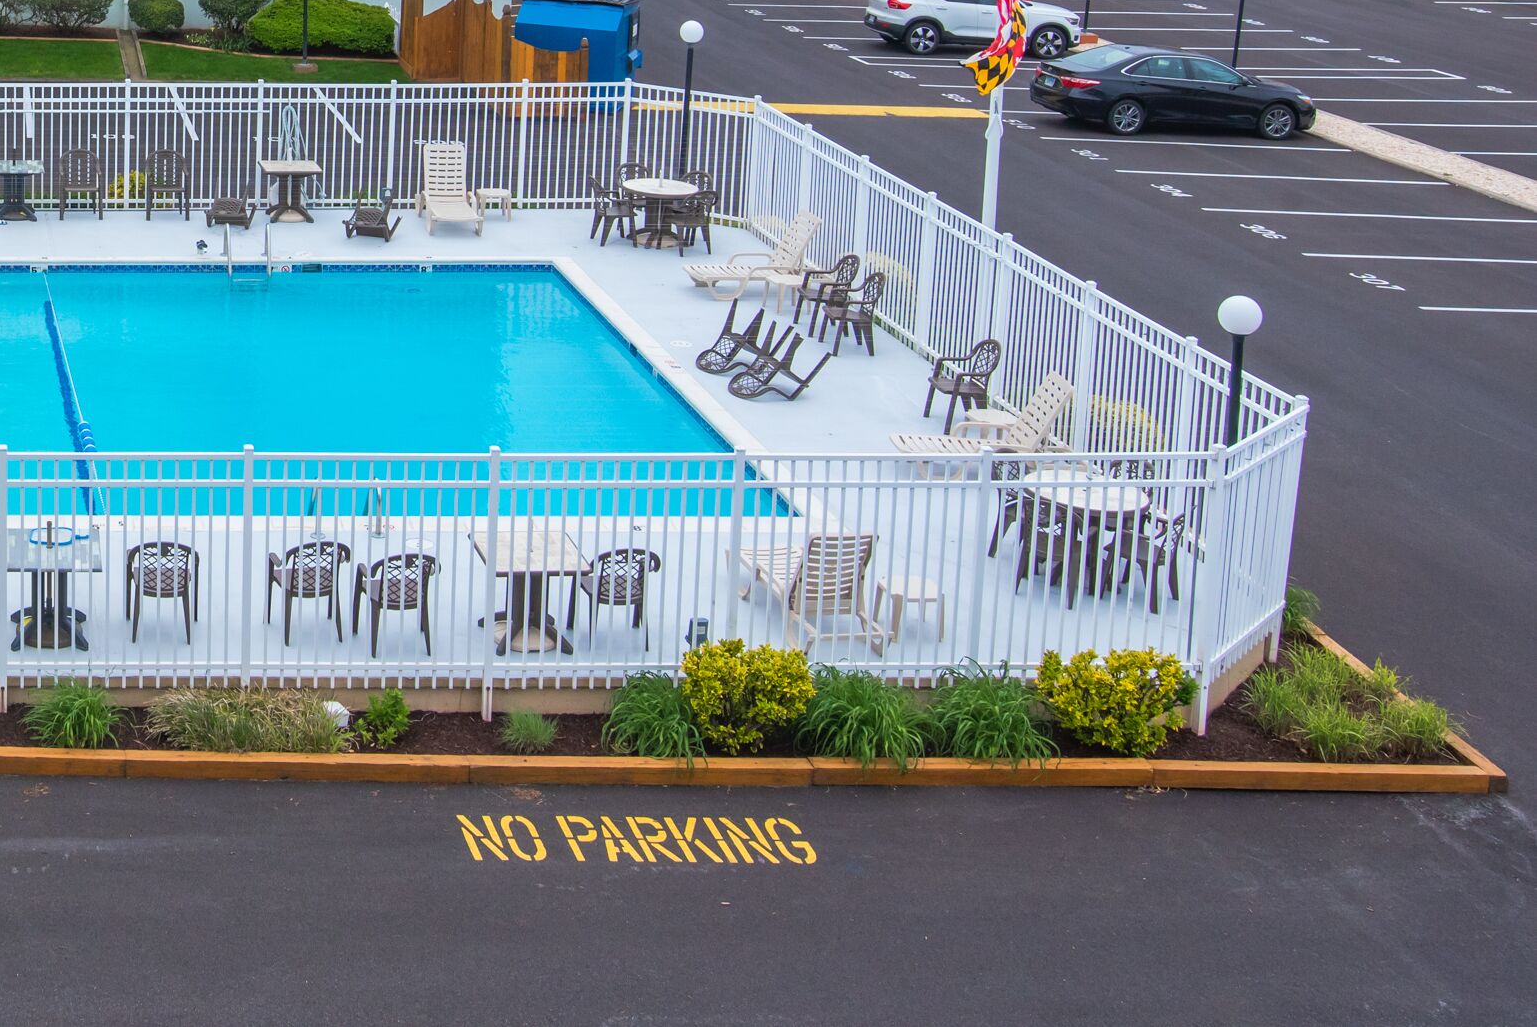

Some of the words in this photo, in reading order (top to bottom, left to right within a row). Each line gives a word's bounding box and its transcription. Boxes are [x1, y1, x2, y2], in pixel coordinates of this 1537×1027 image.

[1070, 148, 1109, 160] 301
[1150, 183, 1194, 197] 304
[1239, 223, 1288, 240] 306
[1349, 272, 1406, 292] 307
[455, 814, 547, 862] NO
[555, 815, 818, 866] PARKING
